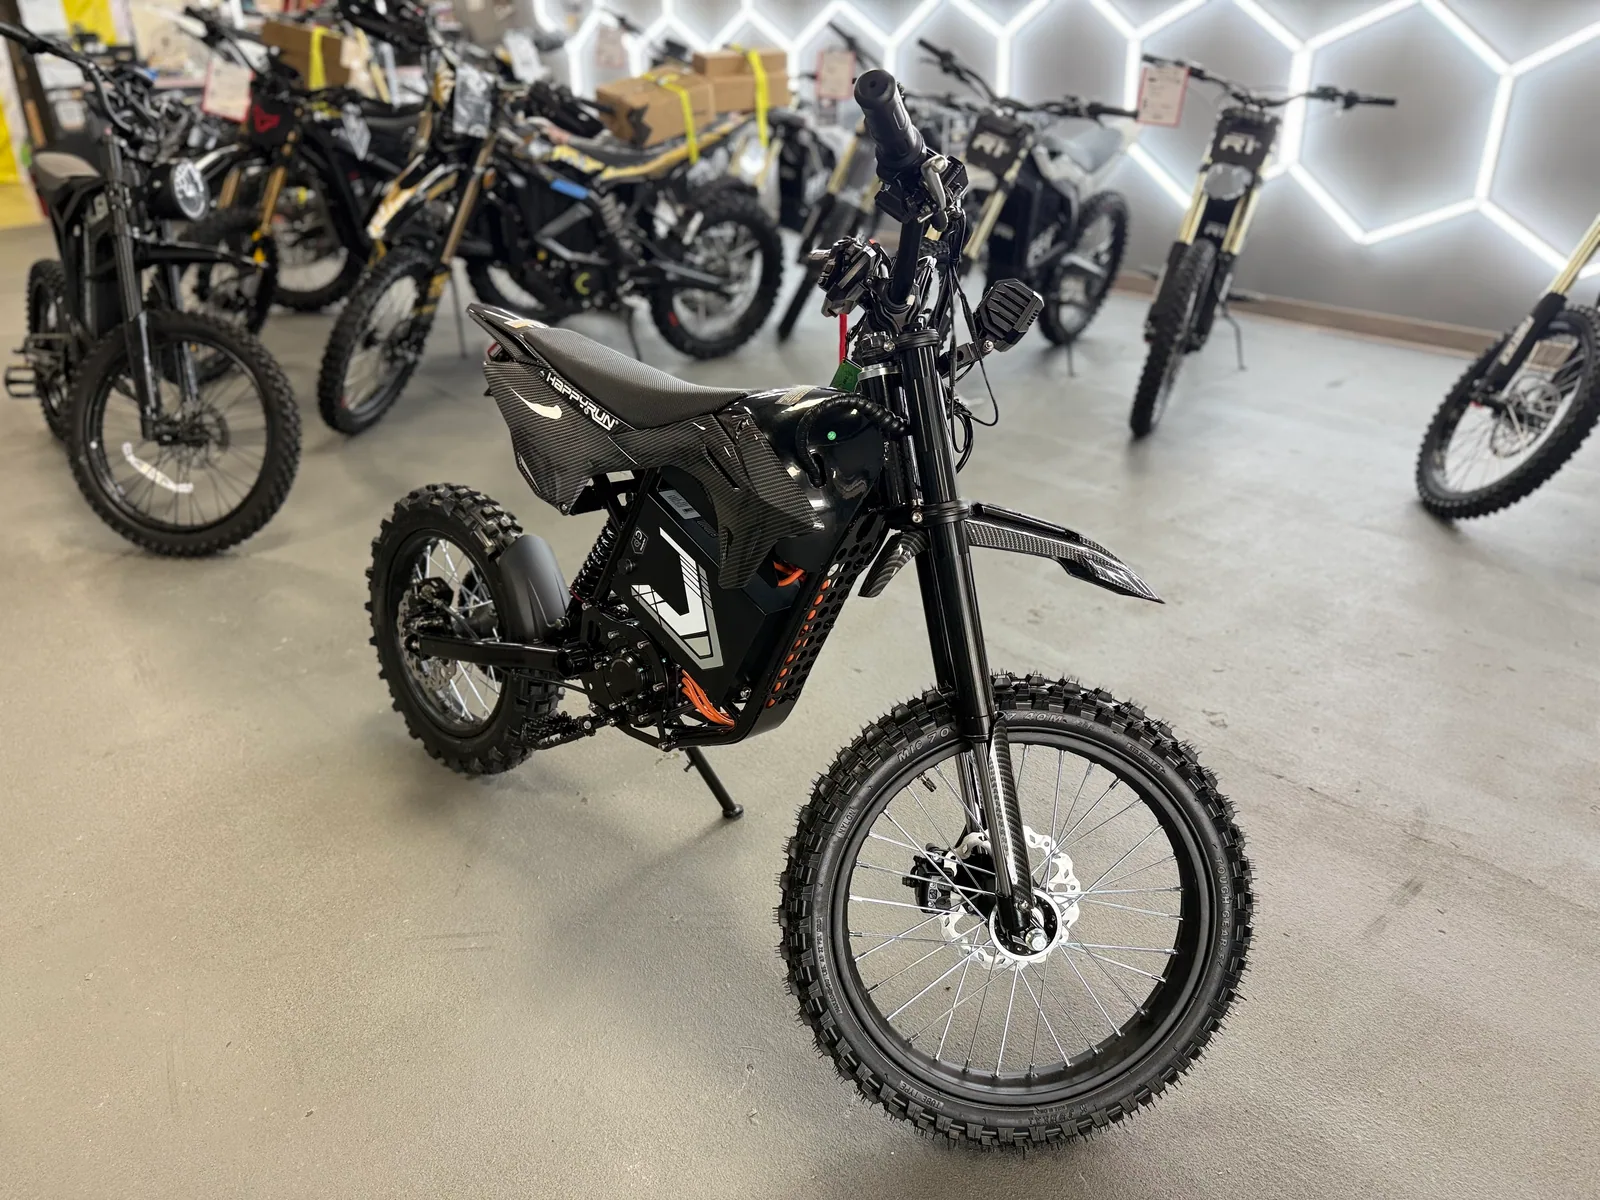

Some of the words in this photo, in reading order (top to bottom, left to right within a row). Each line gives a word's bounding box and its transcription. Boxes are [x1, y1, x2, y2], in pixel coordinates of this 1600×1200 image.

[1216, 857, 1230, 904] TOUGH
[900, 1082, 919, 1099] TYPE
[921, 1095, 941, 1109] TUBE
